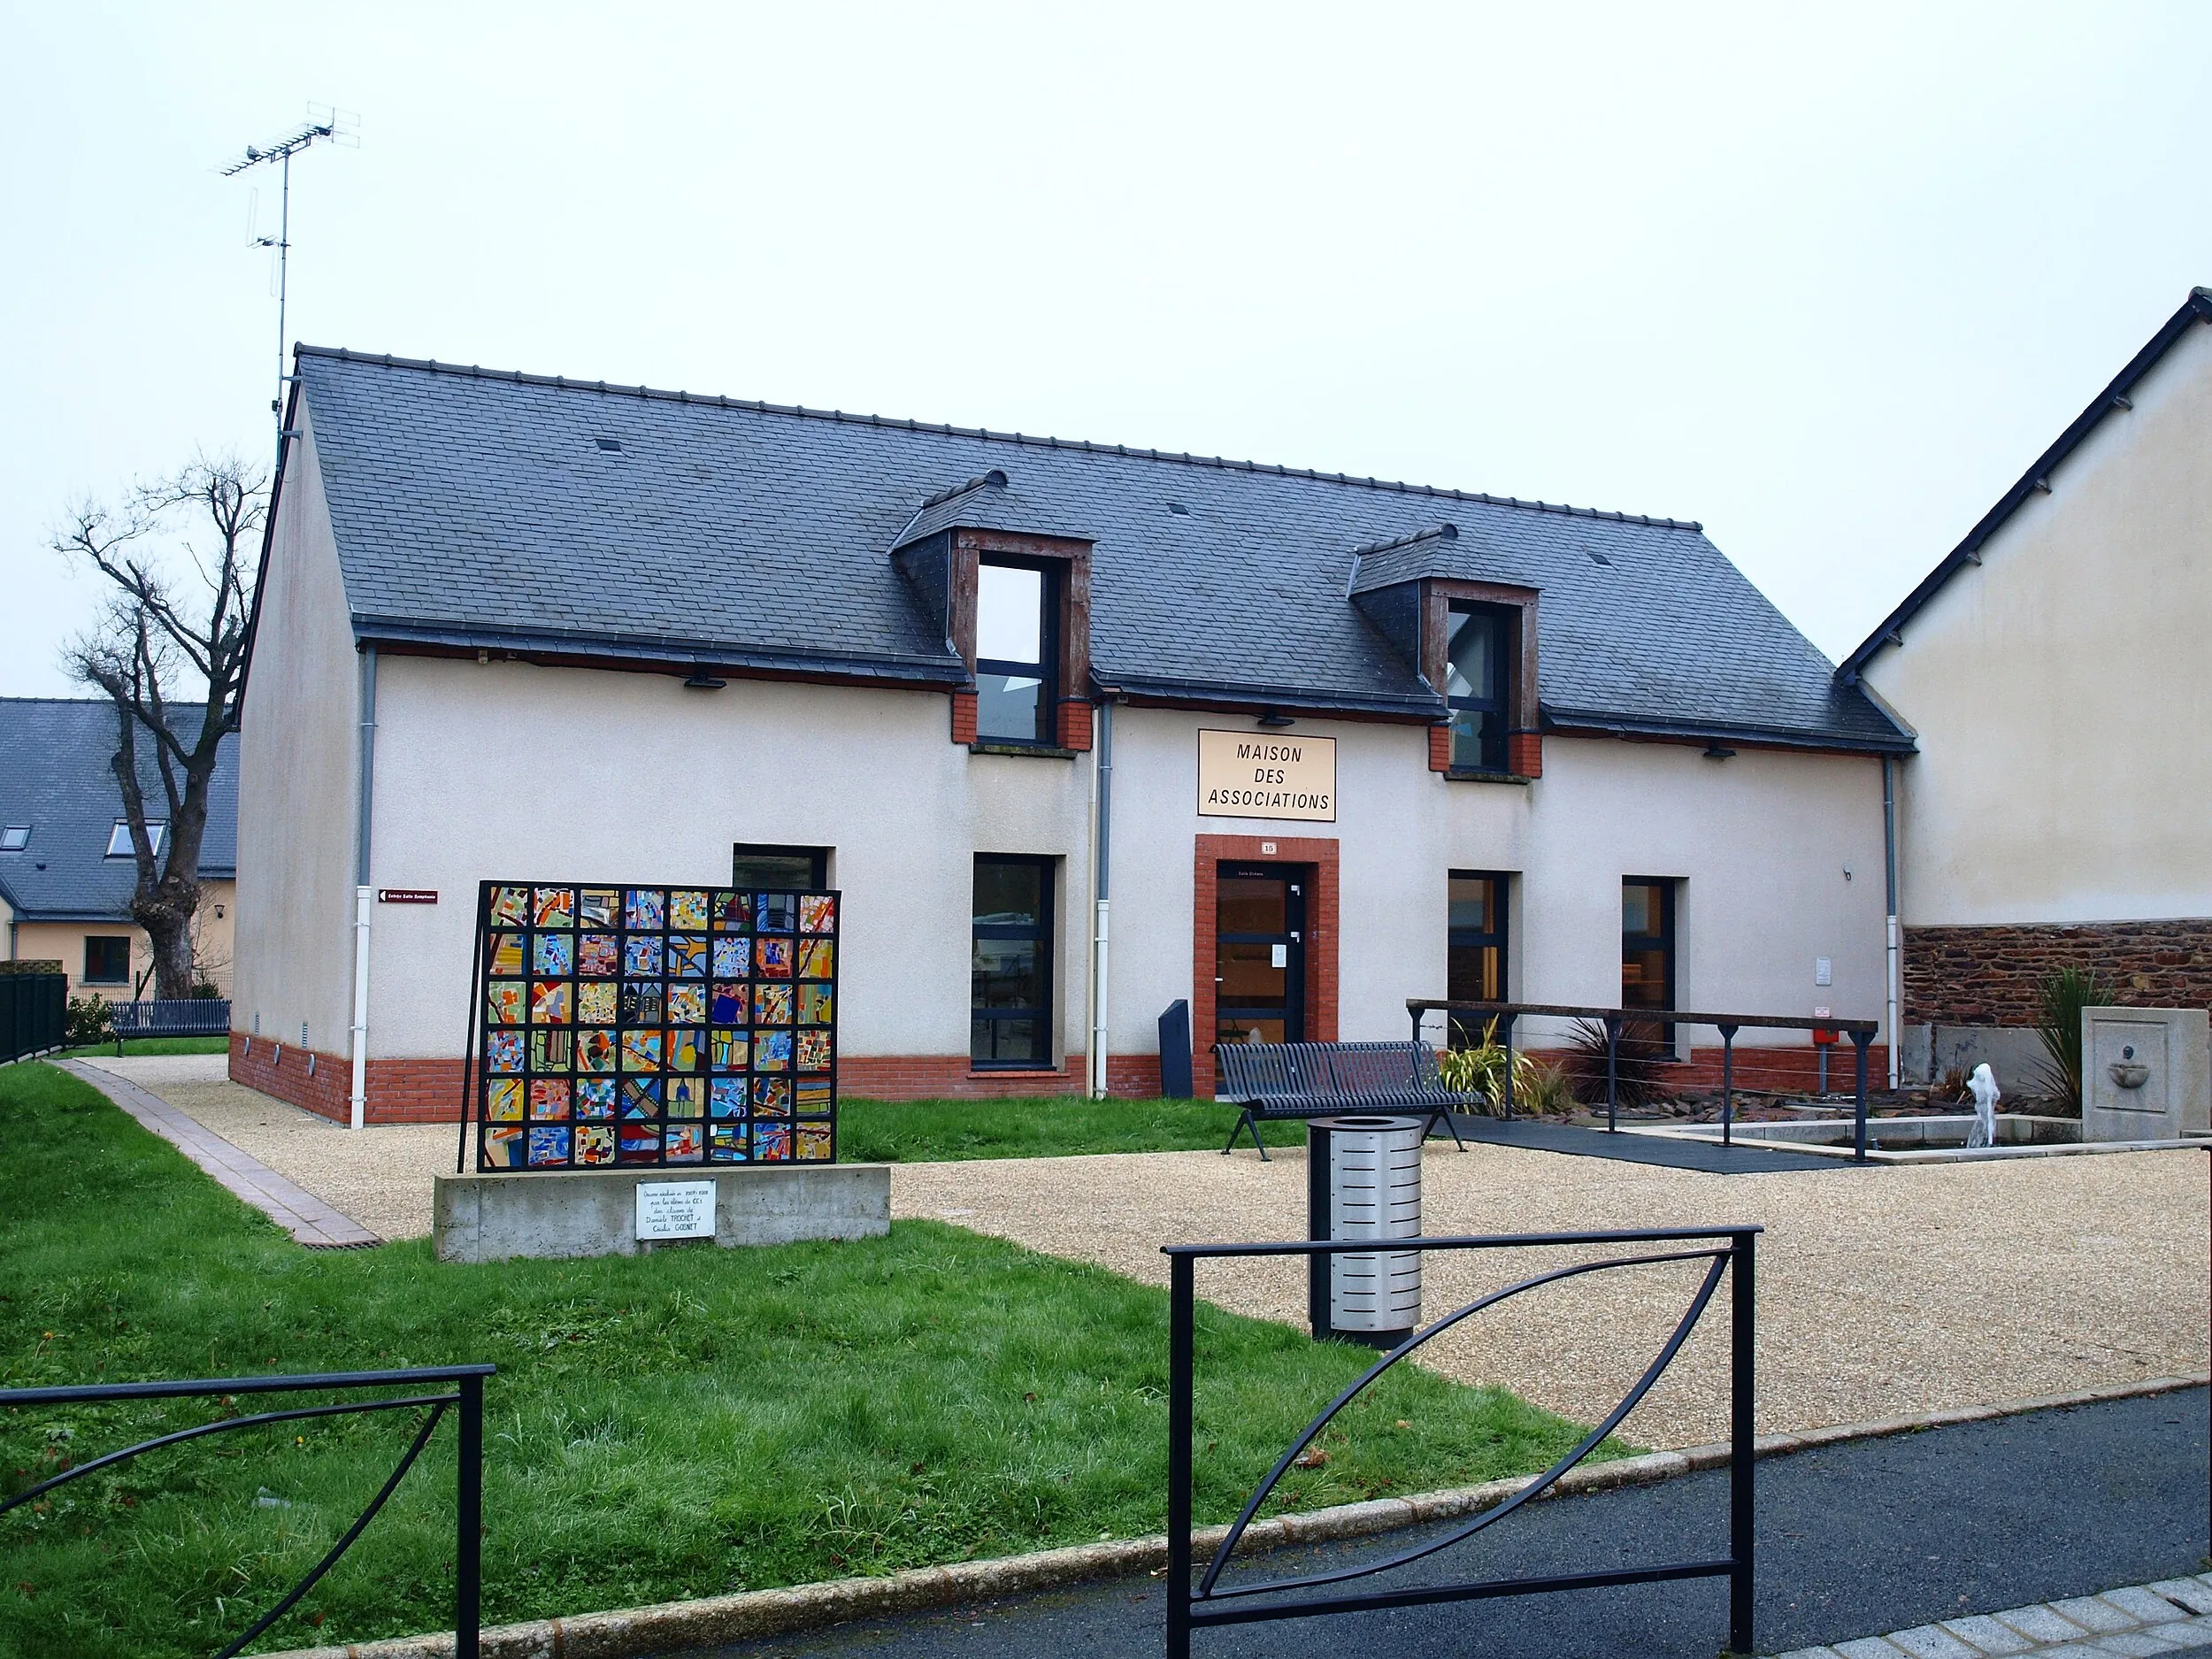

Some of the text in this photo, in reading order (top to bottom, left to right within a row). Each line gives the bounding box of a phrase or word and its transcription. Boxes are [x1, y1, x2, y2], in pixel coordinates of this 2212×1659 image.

[1237, 744, 1302, 763] MAISON
[1255, 768, 1285, 784] DES
[1208, 789, 1329, 810] ASSOCIATIONS
